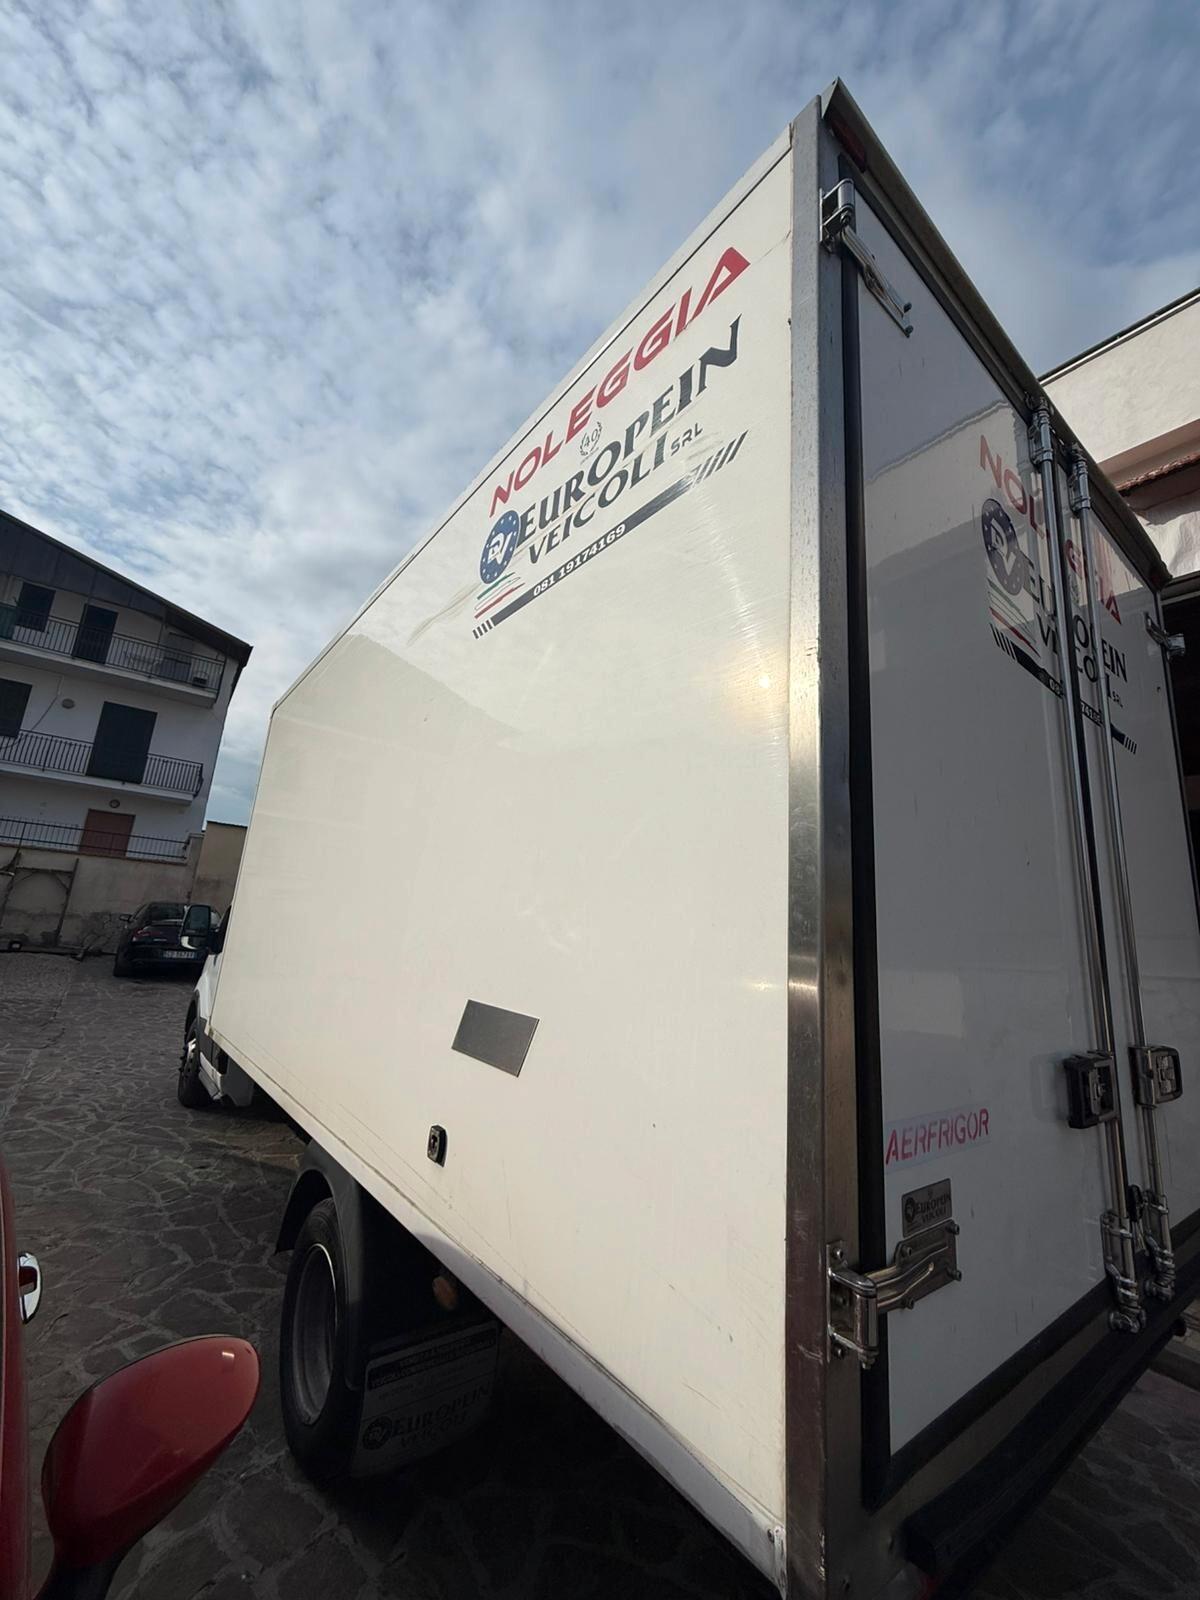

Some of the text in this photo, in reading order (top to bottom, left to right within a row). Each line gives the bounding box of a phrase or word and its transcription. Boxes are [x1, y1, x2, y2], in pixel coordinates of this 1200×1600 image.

[489, 246, 751, 518] NOLEGGIA
[516, 313, 742, 549] EUROPEIN
[528, 422, 703, 564] VEICOLI SRL
[533, 523, 626, 596] 081 19174169
[885, 1108, 989, 1165] AERFRIGOR
